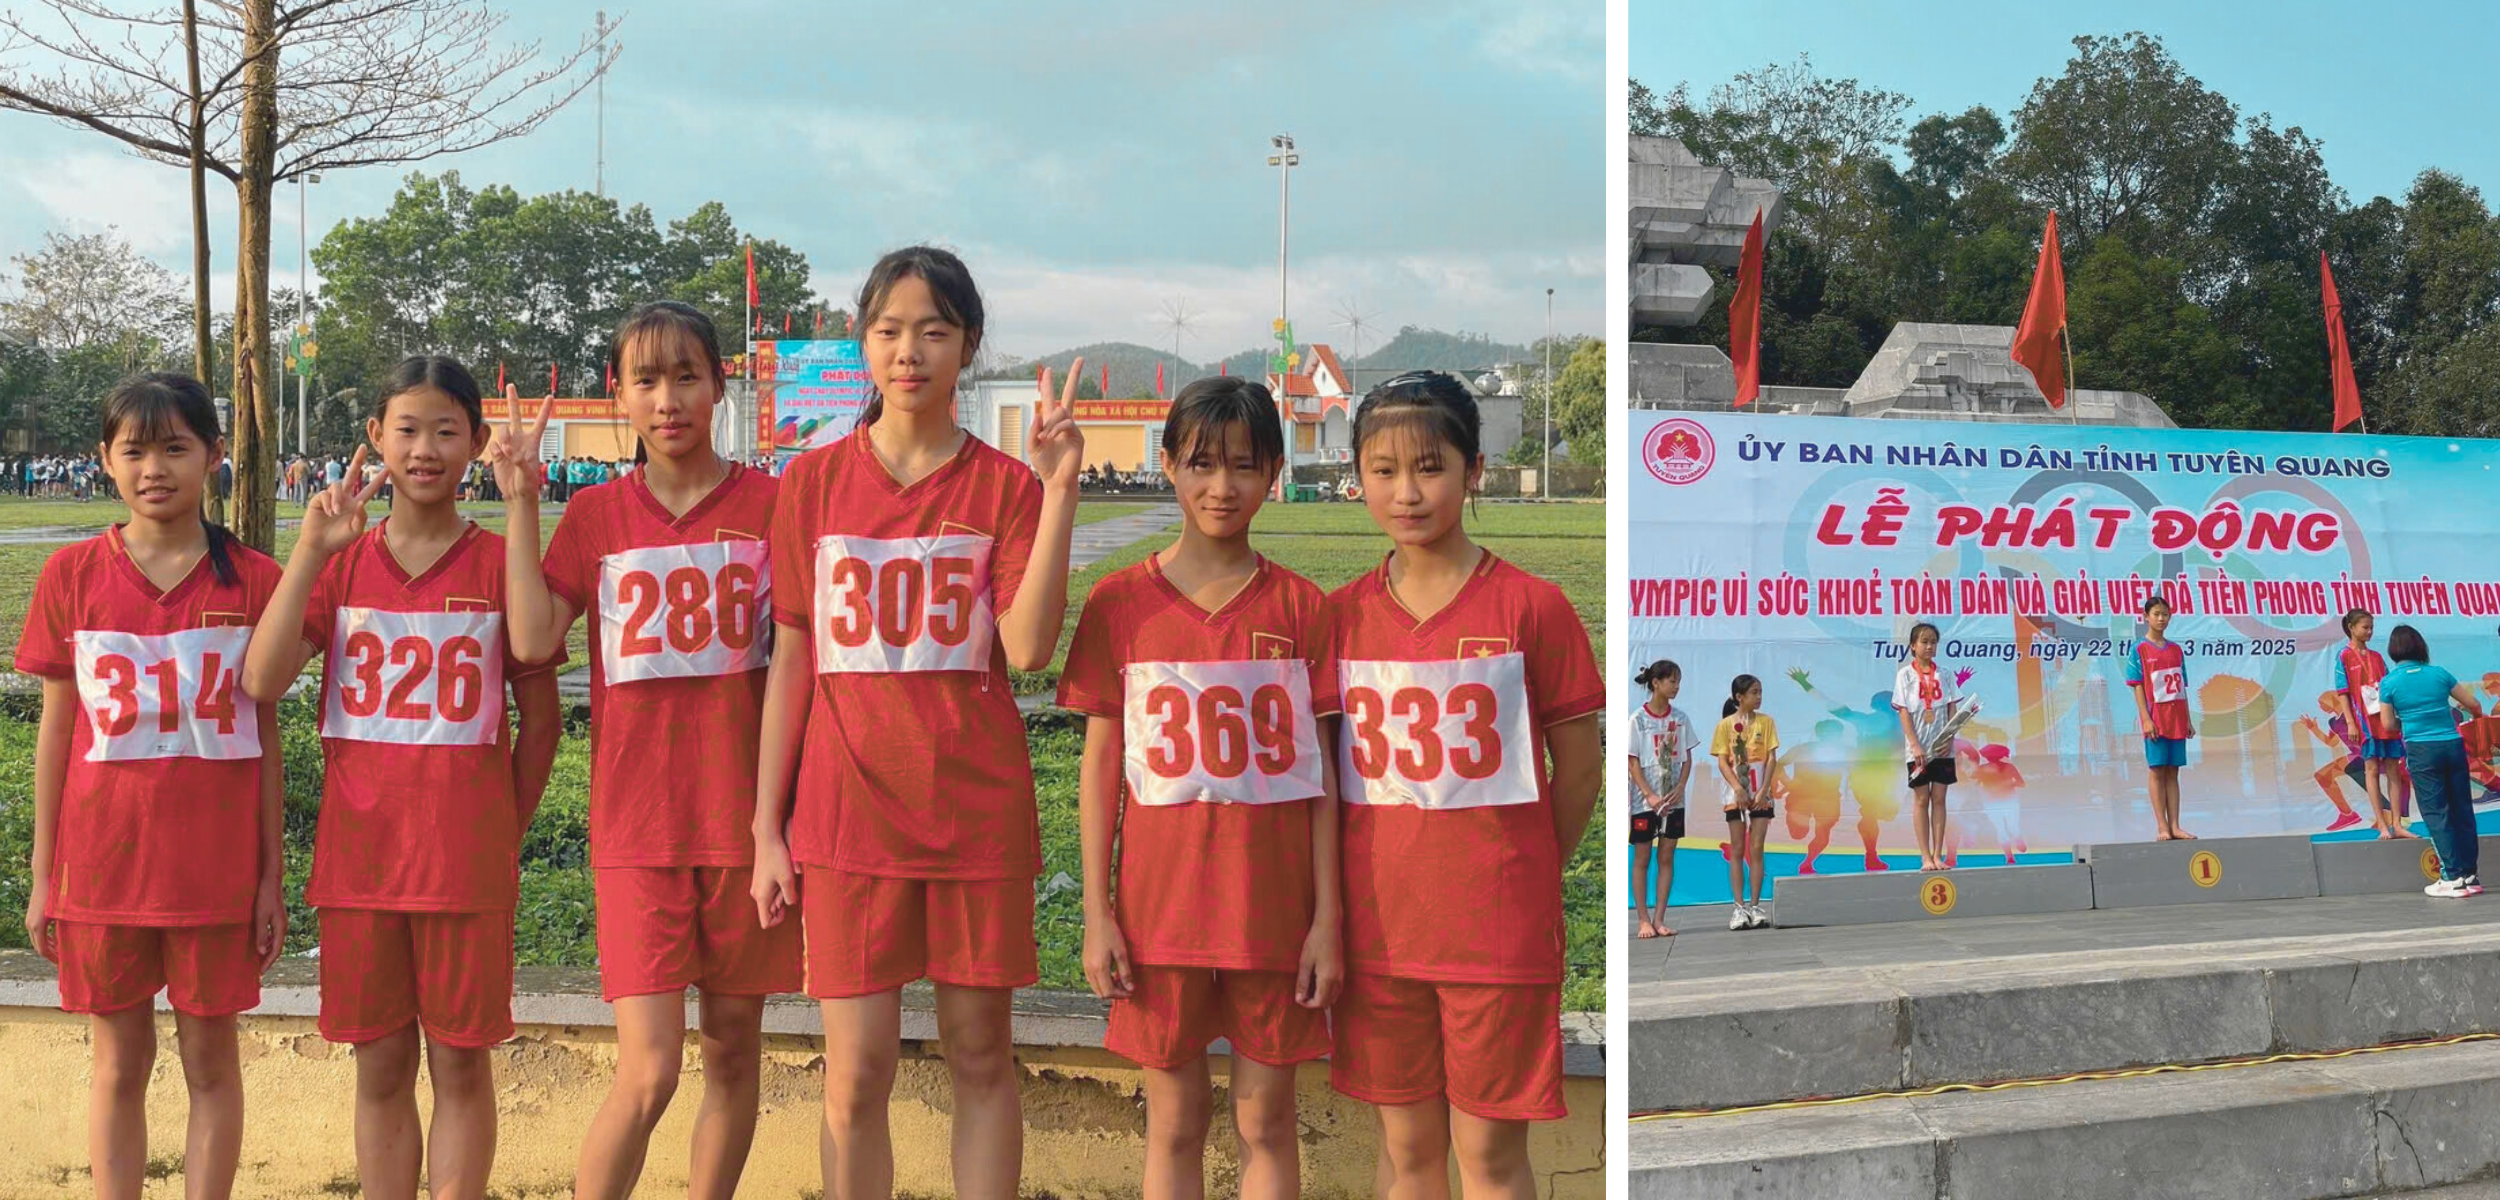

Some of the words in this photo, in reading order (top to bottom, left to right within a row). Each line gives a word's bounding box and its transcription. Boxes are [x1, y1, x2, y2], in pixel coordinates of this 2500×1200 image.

[822, 369, 850, 382] PHÁT
[1679, 465, 1705, 481] QUANG
[1738, 434, 1786, 463] ỦY
[1800, 442, 1873, 465] BAN
[1887, 442, 1987, 468] NHÂN
[2001, 444, 2072, 470] DÂN
[2083, 444, 2158, 473] TỈNH
[2167, 449, 2265, 475] TUYÊN
[2276, 457, 2391, 478] QUANG
[1816, 487, 1910, 547] LỄ
[1936, 498, 2131, 549] PHÁT
[2152, 501, 2339, 558] ĐỘNG
[617, 562, 756, 658] 286
[830, 556, 975, 648] 305
[1628, 578, 1717, 617] YMPIC
[1722, 571, 1748, 616] VÌ
[1757, 571, 1809, 616] SỨC
[1818, 568, 1883, 616] KHOẺ
[1891, 572, 1953, 615] TOÀN
[1962, 572, 2009, 615] DÂN
[2016, 572, 2048, 615] VÀ
[2054, 569, 2099, 615] GIẢI
[2107, 572, 2156, 623] VIỆT
[2198, 567, 2244, 615] TIỀN
[2255, 580, 2325, 615] PHONG
[2331, 571, 2382, 615] TỈNH
[2385, 575, 2452, 615] TUYÊN
[1946, 639, 2022, 662] Quang,
[2030, 639, 2079, 662] ngày
[2087, 639, 2111, 657] 22
[2184, 639, 2195, 657] 3
[2202, 639, 2244, 657] năm
[2251, 638, 2296, 656] 2025
[94, 653, 236, 737] 314
[341, 631, 483, 723] 326
[1146, 683, 1297, 779] 369
[1345, 683, 1503, 780] 333
[1931, 885, 1947, 906] 3
[2200, 858, 2212, 880] 1
